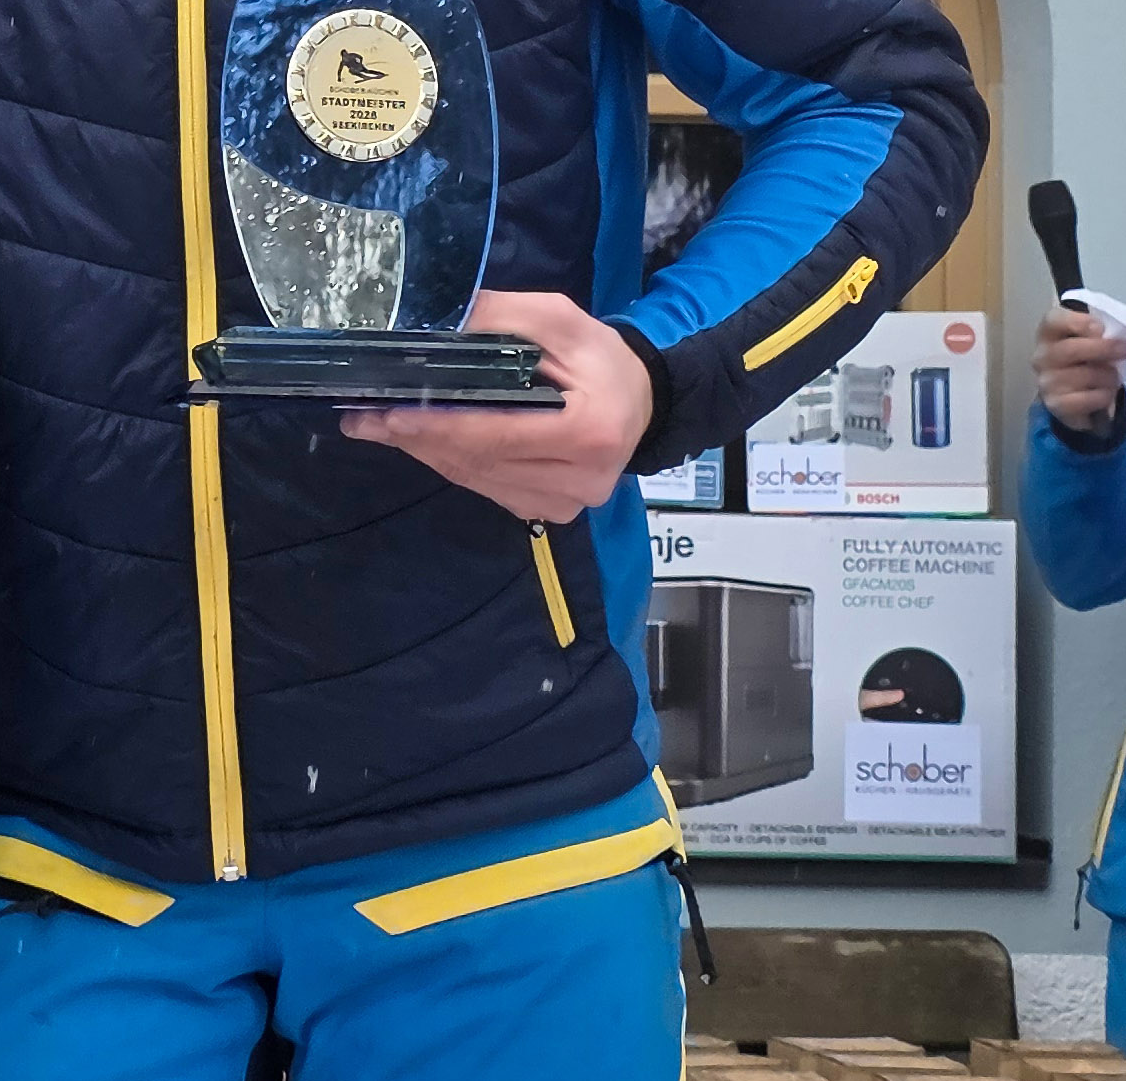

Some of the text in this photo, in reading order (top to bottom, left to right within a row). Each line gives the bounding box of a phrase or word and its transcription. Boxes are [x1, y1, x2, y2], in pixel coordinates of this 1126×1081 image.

[321, 97, 406, 109] STADTMEISTER
[756, 456, 842, 486] schober
[857, 493, 900, 505] BOSCH
[842, 538, 1003, 556] FULLY AUTOMATIC
[842, 556, 996, 575] COFFEE MACHINE
[841, 594, 936, 610] COFFEE CHEF
[855, 742, 973, 784] schober
